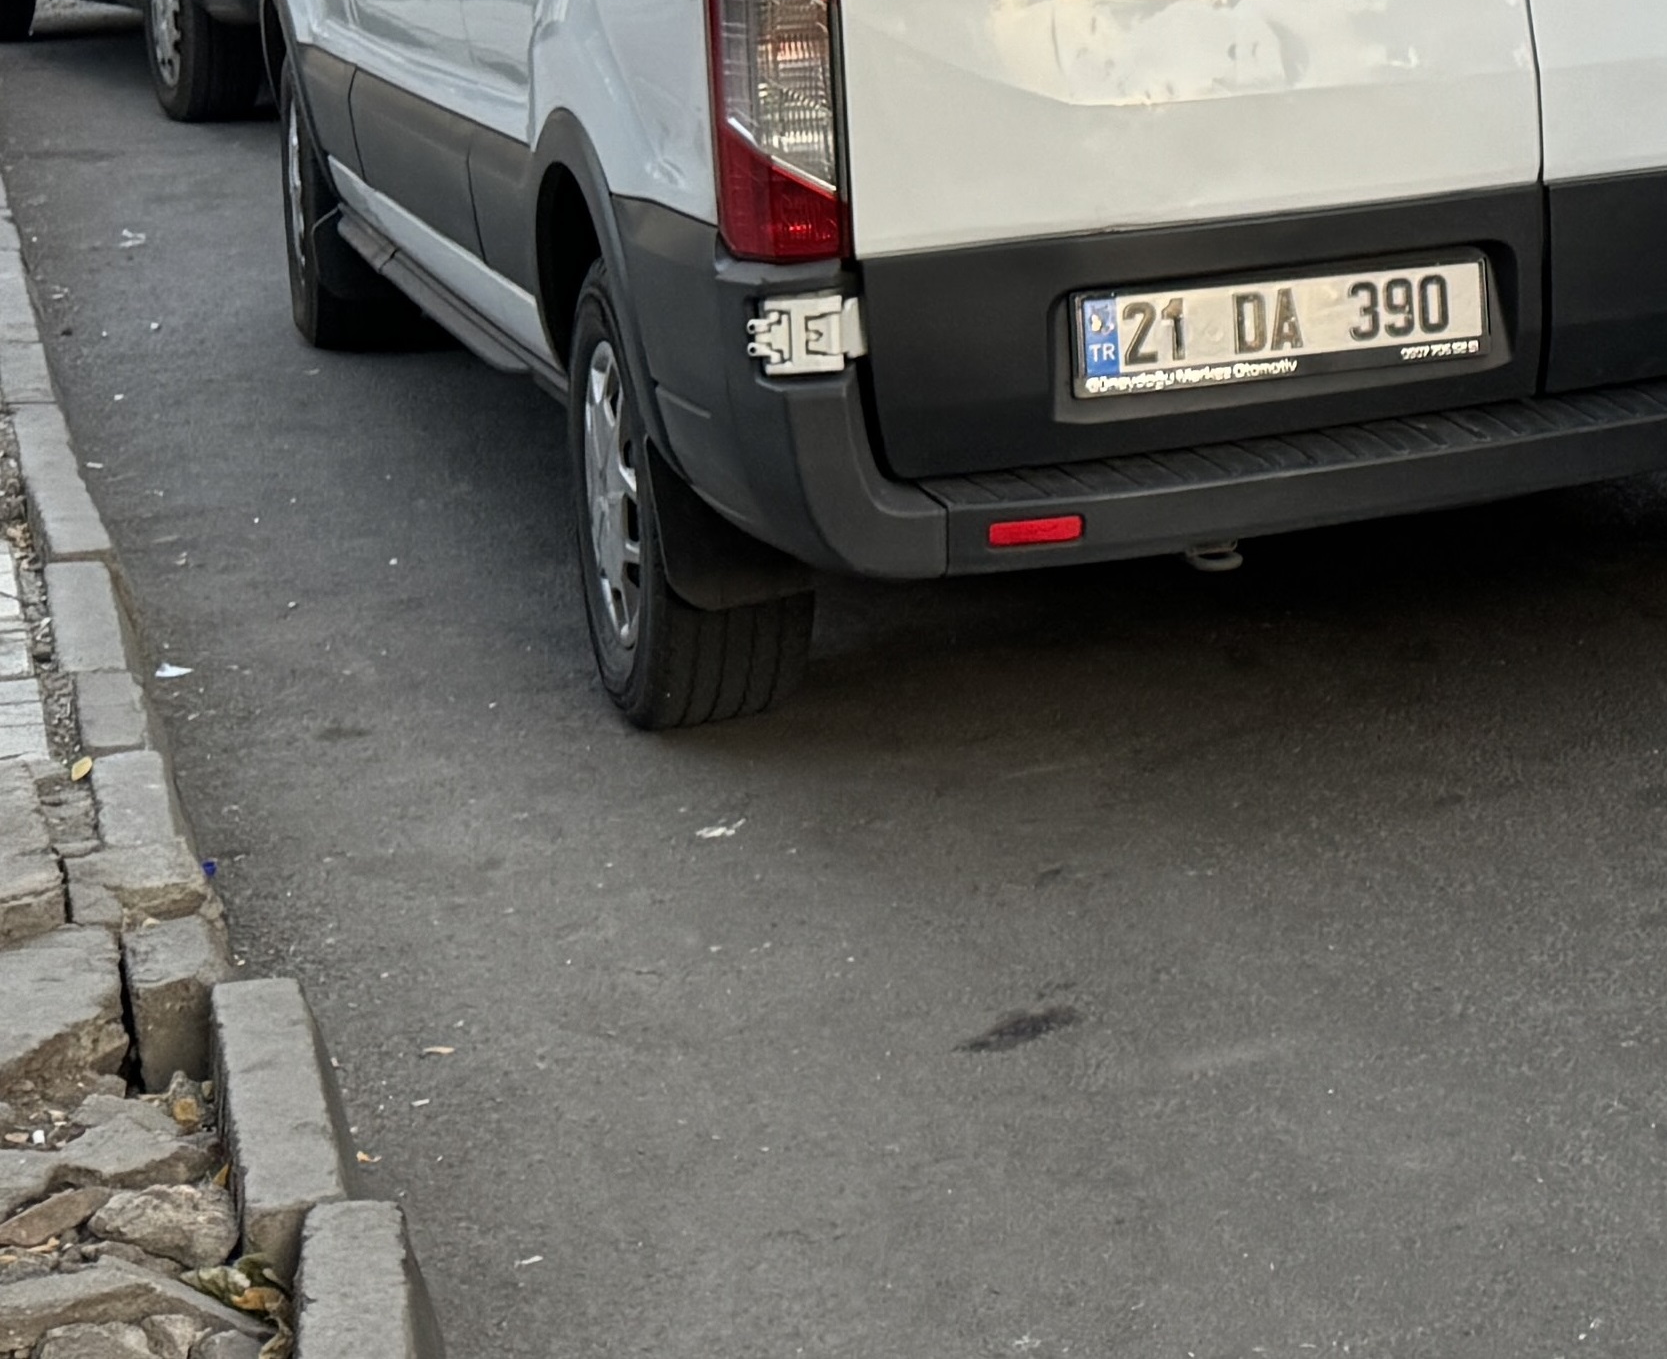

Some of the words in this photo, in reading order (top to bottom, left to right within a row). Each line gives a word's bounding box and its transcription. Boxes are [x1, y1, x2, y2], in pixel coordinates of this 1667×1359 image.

[1122, 298, 1185, 366] 21
[1232, 288, 1304, 354] DA
[1348, 273, 1449, 342] 390
[1089, 342, 1116, 362] TR
[1233, 358, 1298, 378] Otomotiv
